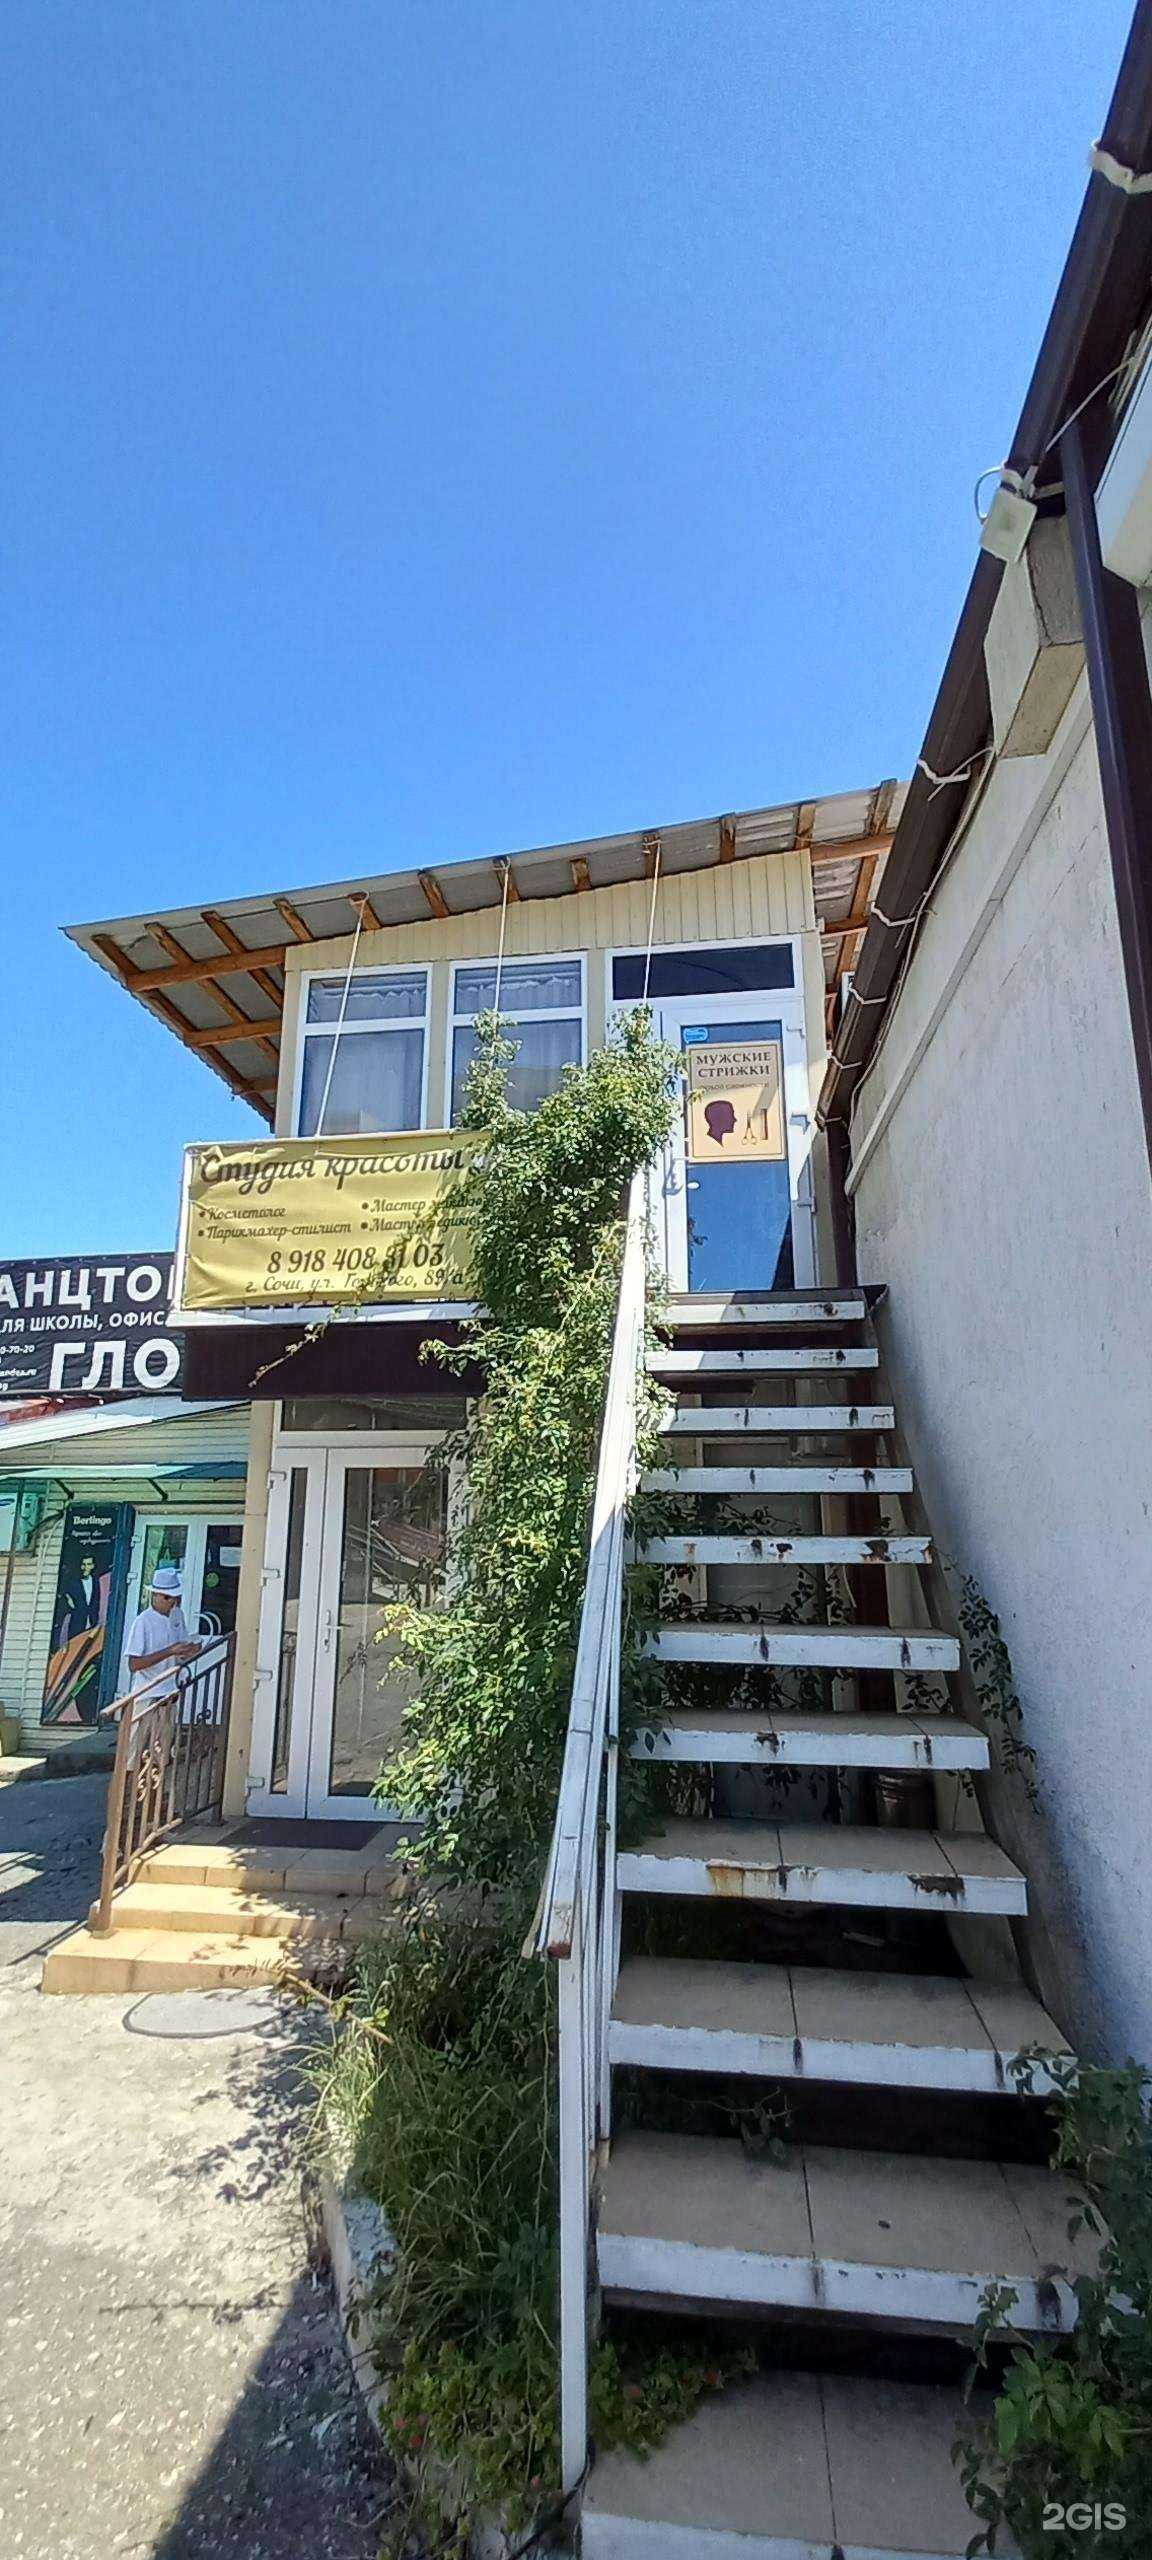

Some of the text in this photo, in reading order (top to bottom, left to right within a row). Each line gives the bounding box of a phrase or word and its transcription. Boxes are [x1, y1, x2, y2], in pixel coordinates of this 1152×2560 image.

[696, 1052, 771, 1066] МУЖСКИЕ
[698, 1065, 770, 1078] СТРИЖКИ
[201, 1149, 465, 1194] Студия красоты
[267, 1251, 282, 1273] 8
[288, 1249, 326, 1273] 918
[332, 1246, 376, 1271] 408
[413, 1243, 445, 1268] 03
[0, 1265, 175, 1311] АНЦТО
[0, 1318, 25, 1334] ЛЯ
[30, 1314, 103, 1333] ШКОЛЫ,
[73, 1515, 112, 1526] Berlingo
